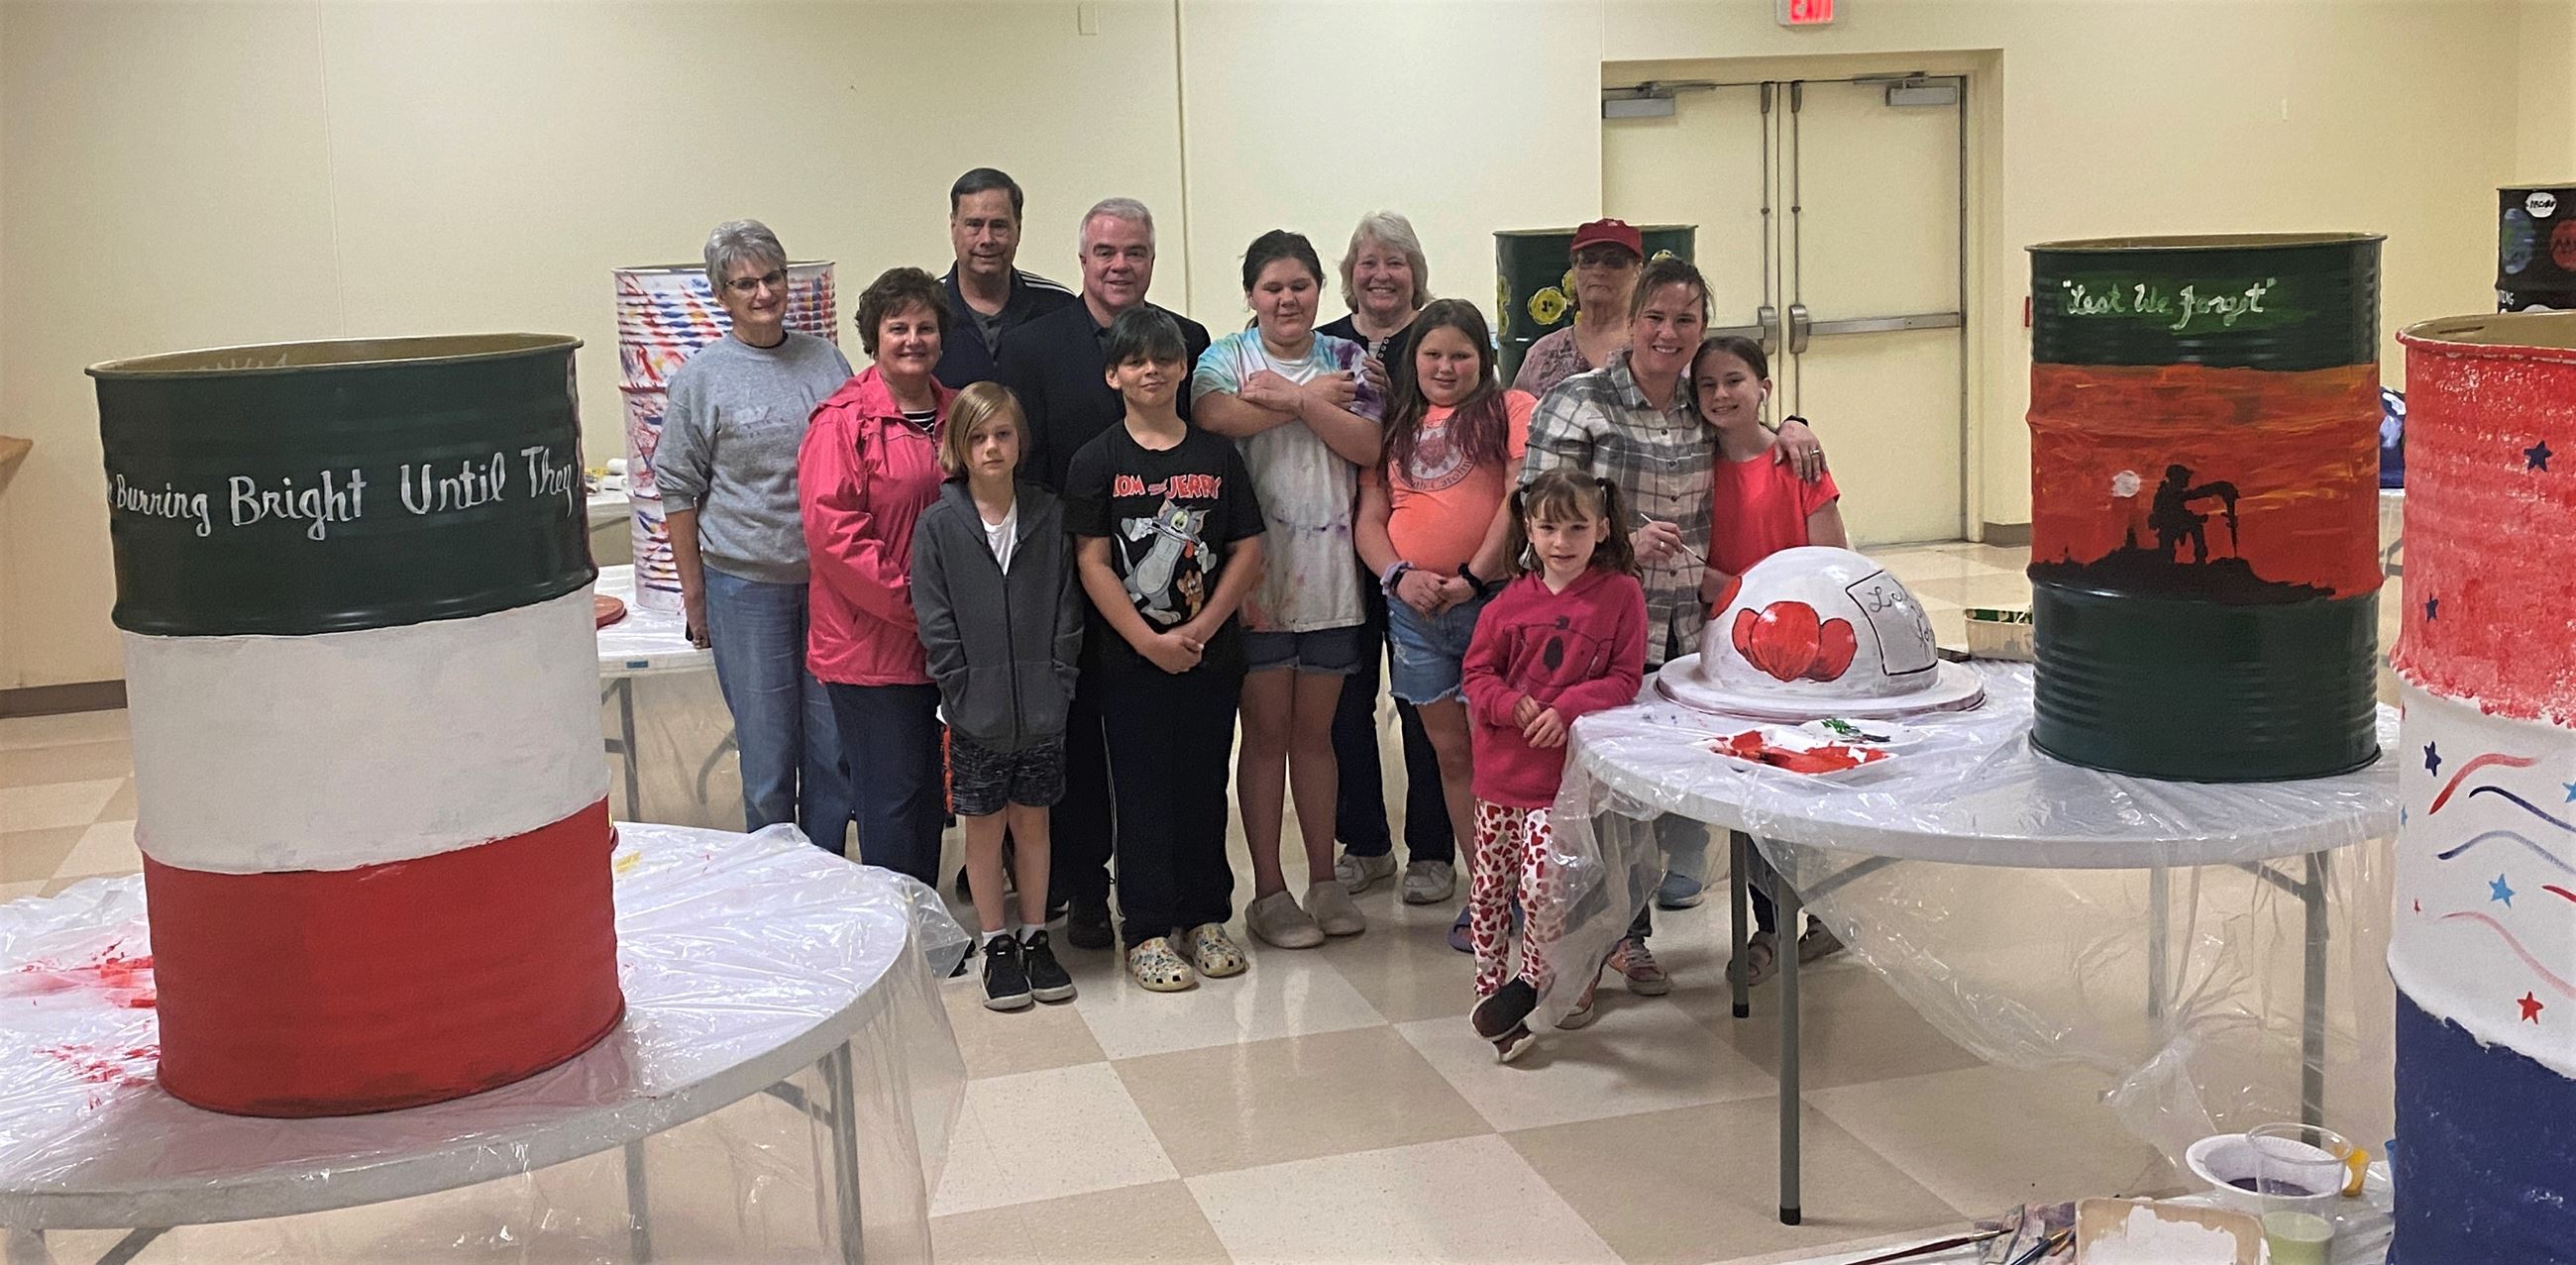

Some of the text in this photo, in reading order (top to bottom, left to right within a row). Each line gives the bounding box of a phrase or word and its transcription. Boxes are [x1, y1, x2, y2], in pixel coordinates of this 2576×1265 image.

[2134, 283, 2173, 314] We
[1165, 474, 1222, 499] JERRY
[1431, 458, 1473, 489] Carolin
[228, 469, 368, 541] Bright
[400, 452, 505, 514] Until
[521, 445, 573, 517] They
